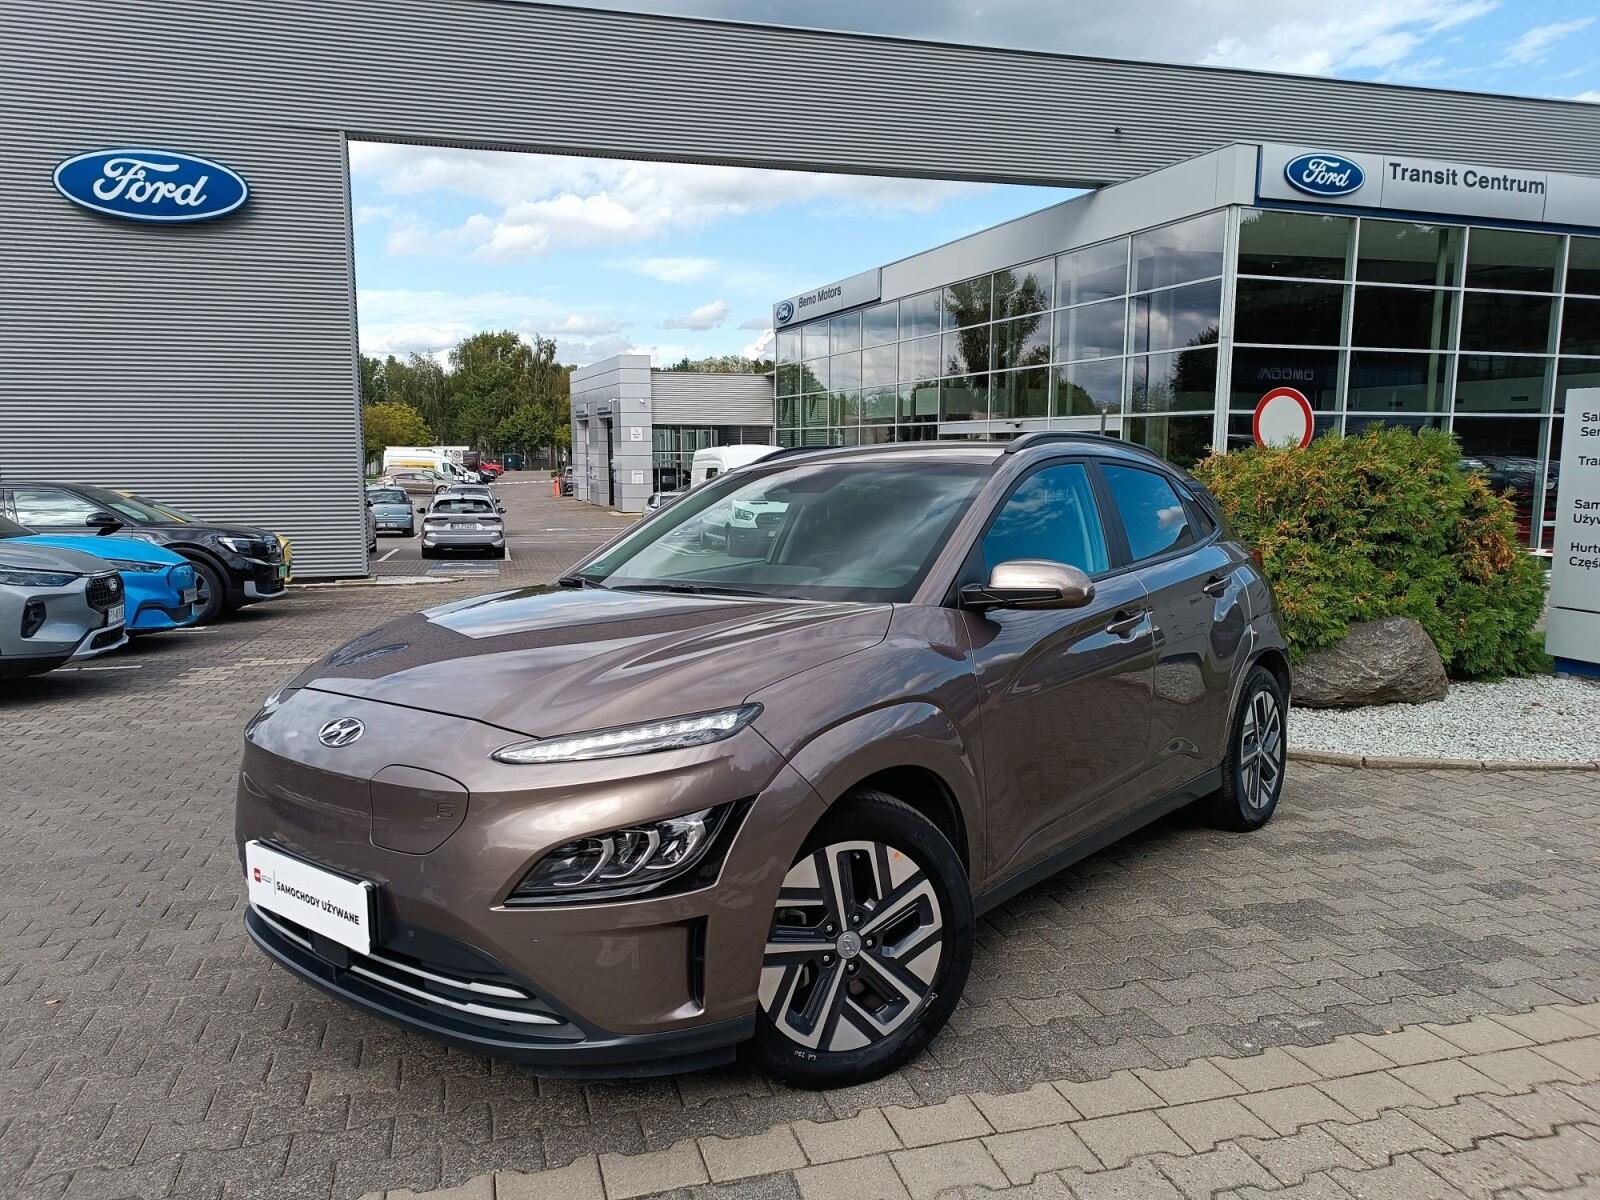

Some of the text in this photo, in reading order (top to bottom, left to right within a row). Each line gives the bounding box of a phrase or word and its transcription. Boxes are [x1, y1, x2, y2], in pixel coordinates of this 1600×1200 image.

[93, 158, 209, 207] Ford
[1303, 159, 1351, 187] Ford
[1389, 162, 1545, 195] Transit Centrum
[798, 286, 842, 309] Bemo Motors
[1578, 455, 1600, 466] Tra
[1569, 556, 1600, 571] Częś
[276, 881, 360, 926] SAMOCHODY UŻYWANE
